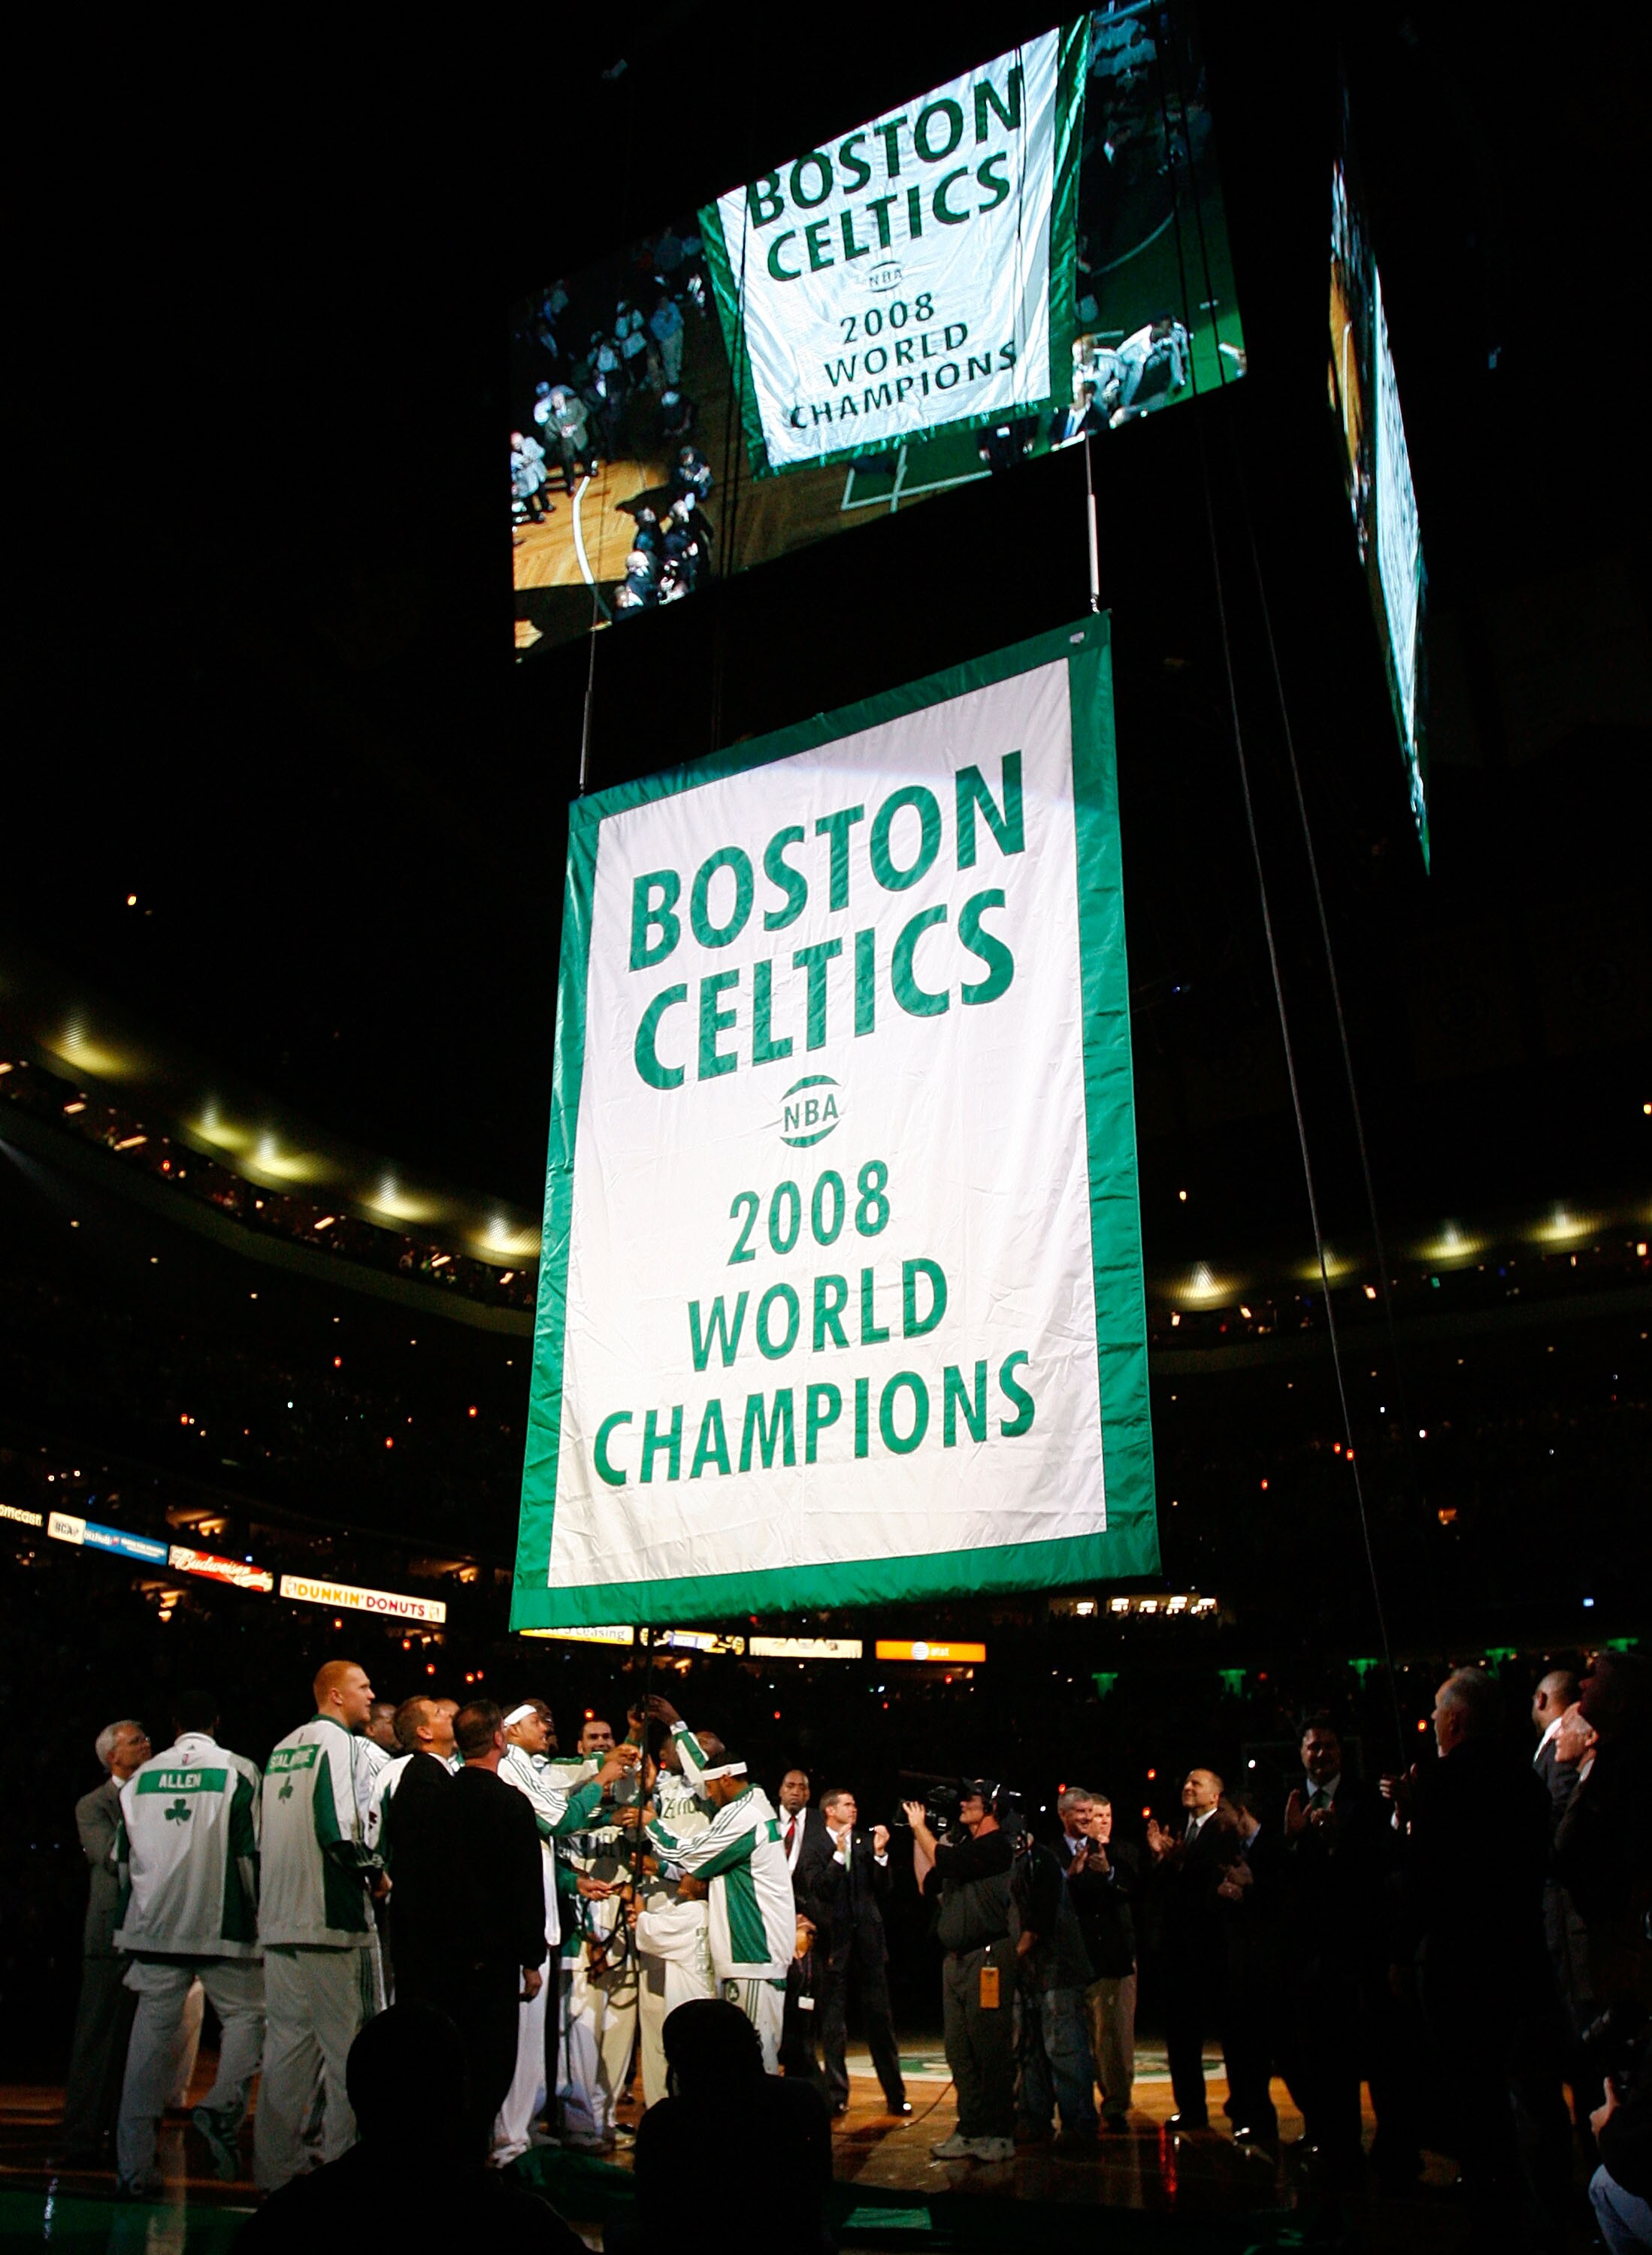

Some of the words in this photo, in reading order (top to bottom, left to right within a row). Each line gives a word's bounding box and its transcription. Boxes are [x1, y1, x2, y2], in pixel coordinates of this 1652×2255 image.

[747, 65, 1021, 229] BOSTON
[767, 151, 1010, 282] CELTICS
[840, 292, 934, 344] 2008
[869, 268, 902, 287] NBA
[790, 341, 1017, 429] CHAMPIONS
[824, 321, 968, 387] WORLD
[628, 749, 1025, 972] BOSTON
[634, 888, 1015, 1091] CELTICS
[784, 1094, 840, 1132] NBA
[727, 1160, 891, 1267] 2008
[687, 1258, 948, 1372] WORLD
[593, 1350, 1036, 1487] CHAMPIONS
[0, 1504, 42, 1527] omcast
[297, 1583, 365, 1606] DUNKIN'
[366, 1595, 425, 1617] DONUTS
[159, 1772, 202, 1789] ALLEN
